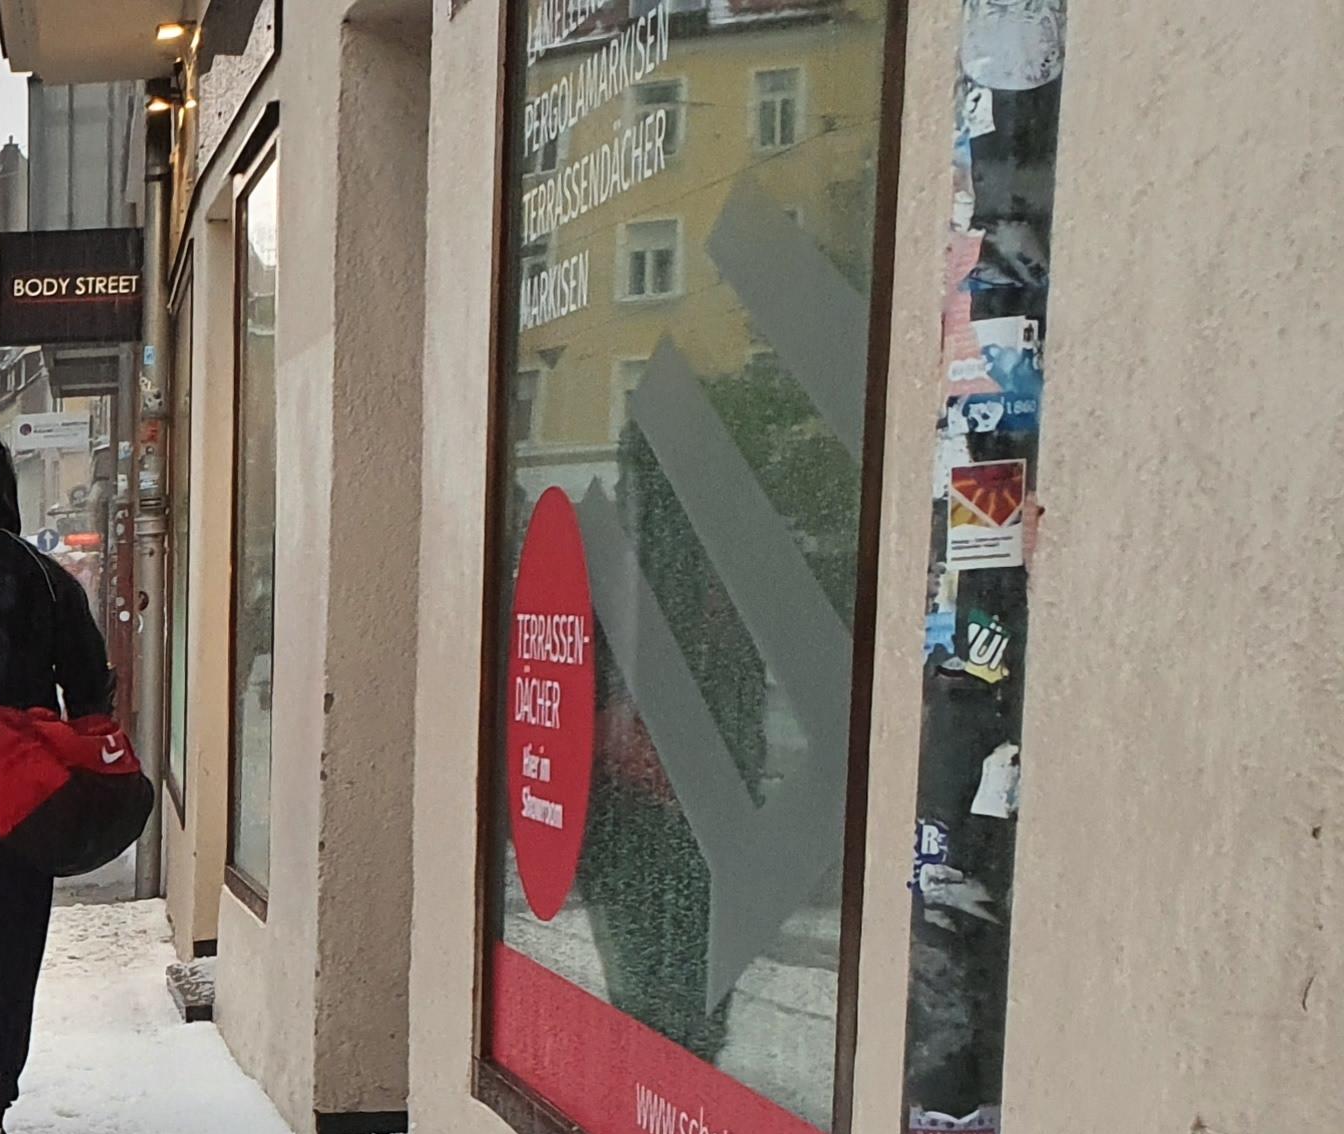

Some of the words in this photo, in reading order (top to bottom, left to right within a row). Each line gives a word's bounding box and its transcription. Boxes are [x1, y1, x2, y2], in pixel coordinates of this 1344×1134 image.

[524, 0, 669, 157] PERGOLAMARKISEN
[522, 109, 666, 244] TERRASSENDÄCHER
[13, 278, 70, 296] BODY
[75, 275, 139, 295] STREET
[519, 249, 589, 332] MARKISEN
[517, 614, 589, 664] TERRASSEN-
[515, 665, 560, 729] DÄCHER
